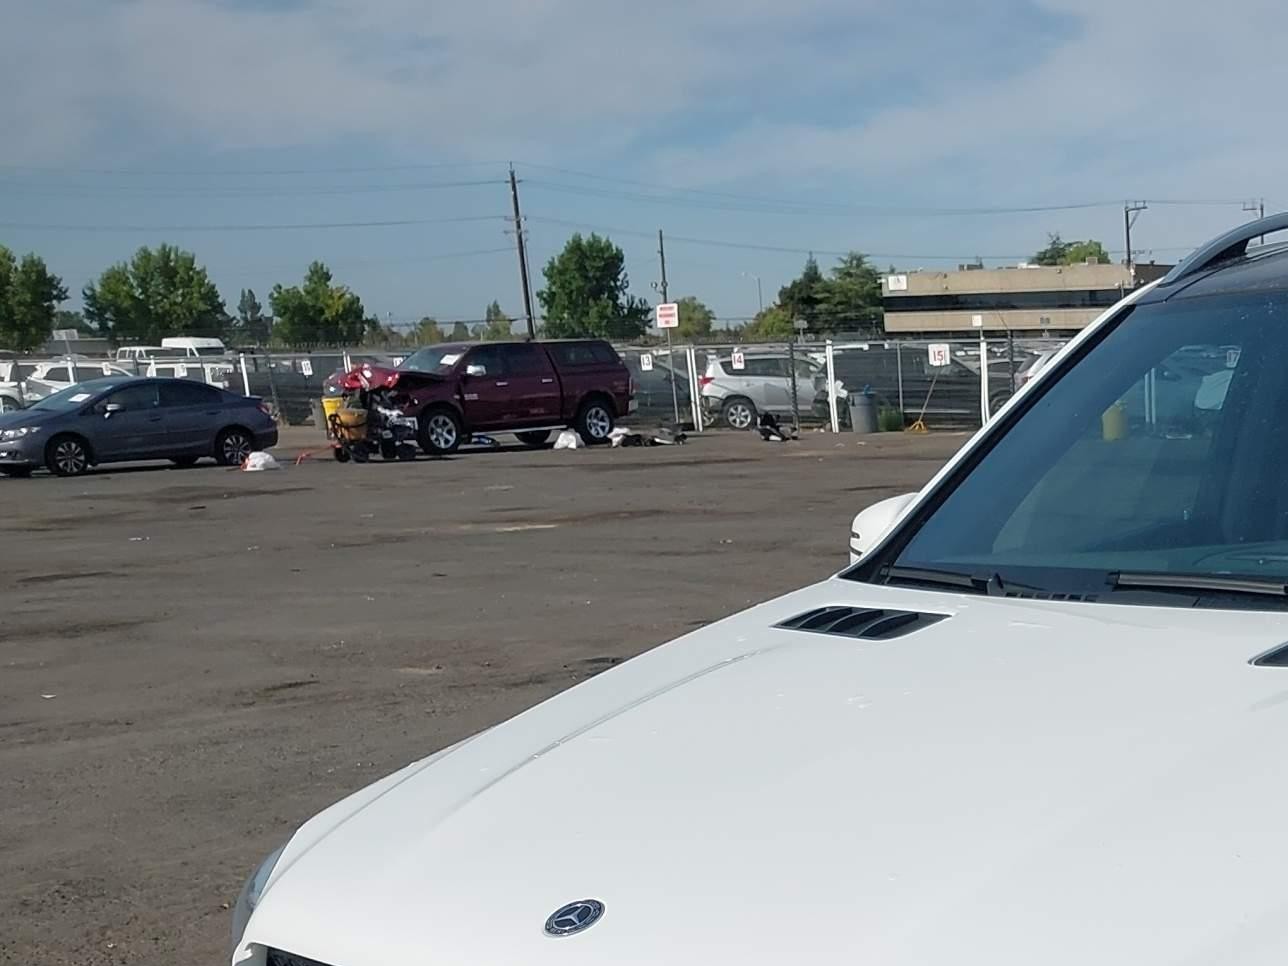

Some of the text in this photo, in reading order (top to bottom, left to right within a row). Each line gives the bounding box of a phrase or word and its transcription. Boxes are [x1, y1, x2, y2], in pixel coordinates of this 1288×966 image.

[641, 356, 651, 366] 13
[732, 354, 742, 365] 14
[933, 350, 944, 362] 15
